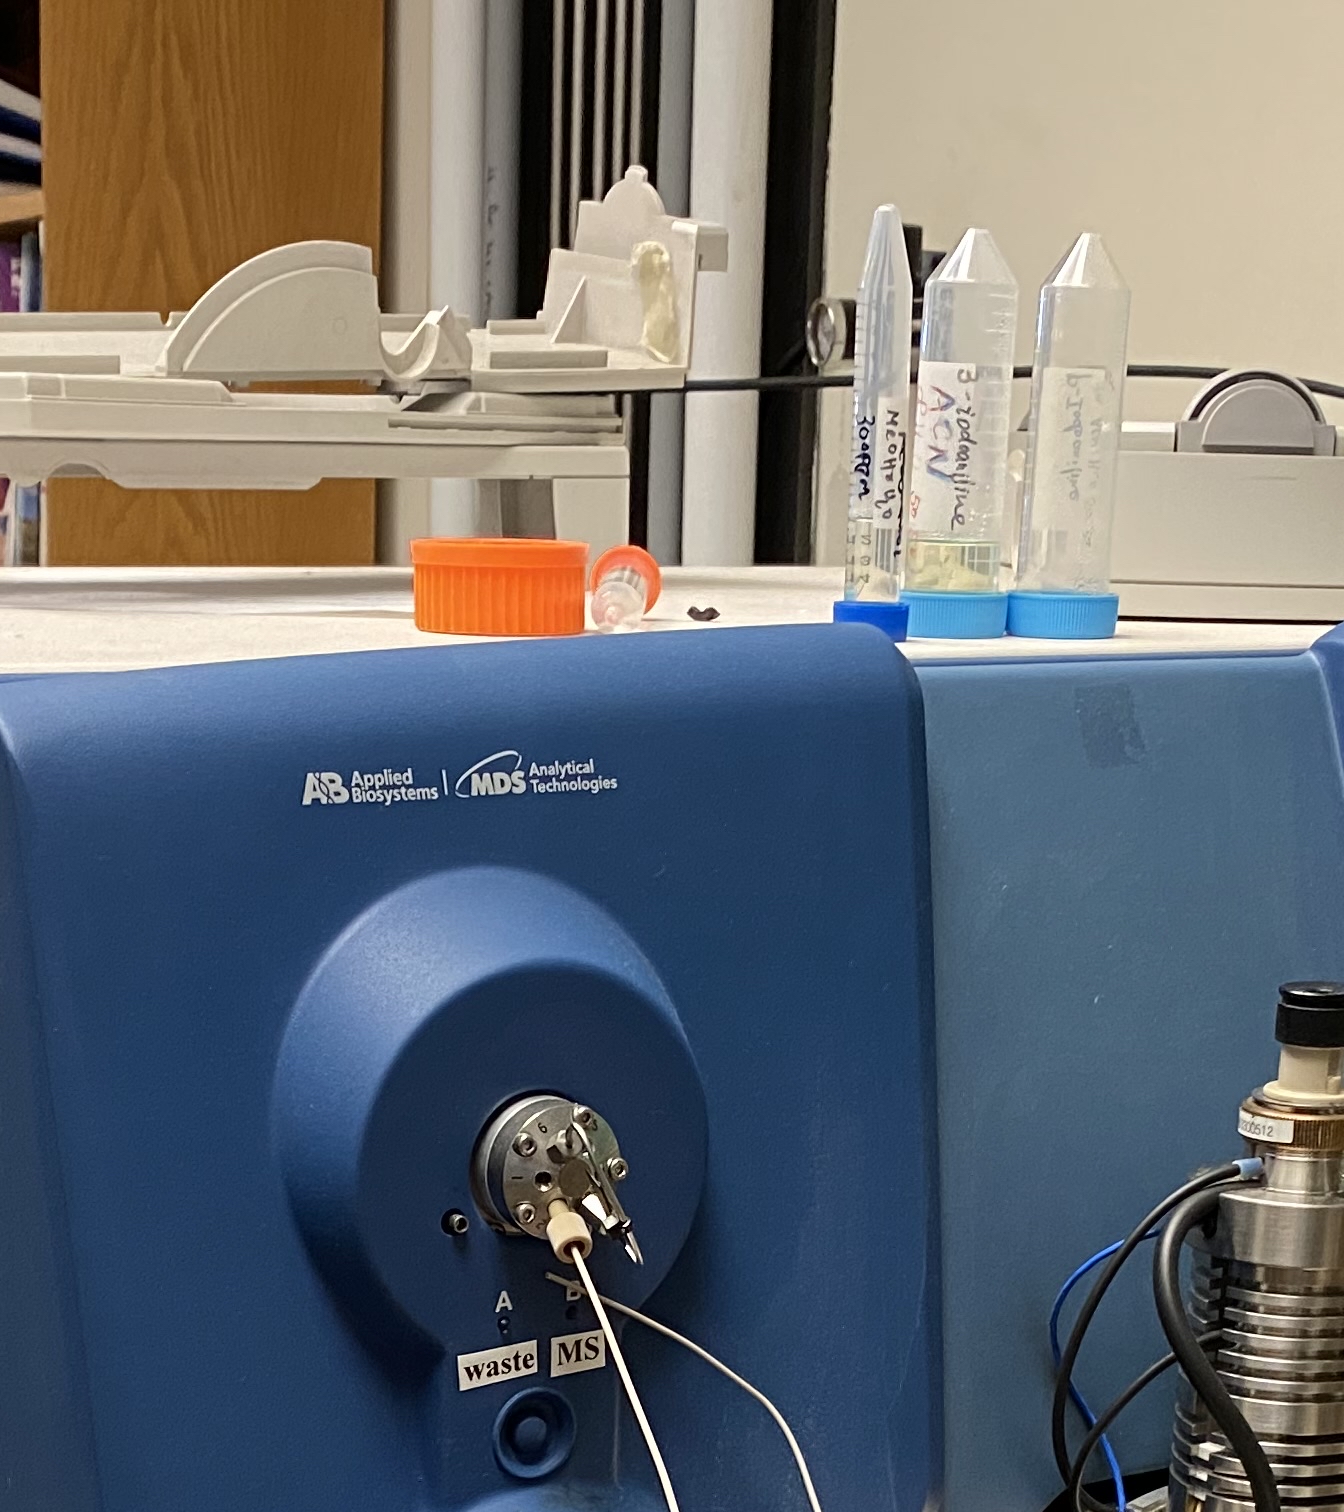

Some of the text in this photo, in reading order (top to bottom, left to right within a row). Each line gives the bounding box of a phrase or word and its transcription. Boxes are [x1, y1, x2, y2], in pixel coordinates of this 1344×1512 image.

[352, 767, 413, 789] Applied
[471, 759, 594, 796] MDS Analytical
[529, 776, 618, 794] Technologies
[352, 785, 438, 805] Biosystems
[495, 1290, 513, 1313] A
[557, 1336, 600, 1366] MS
[464, 1349, 535, 1382] waste
